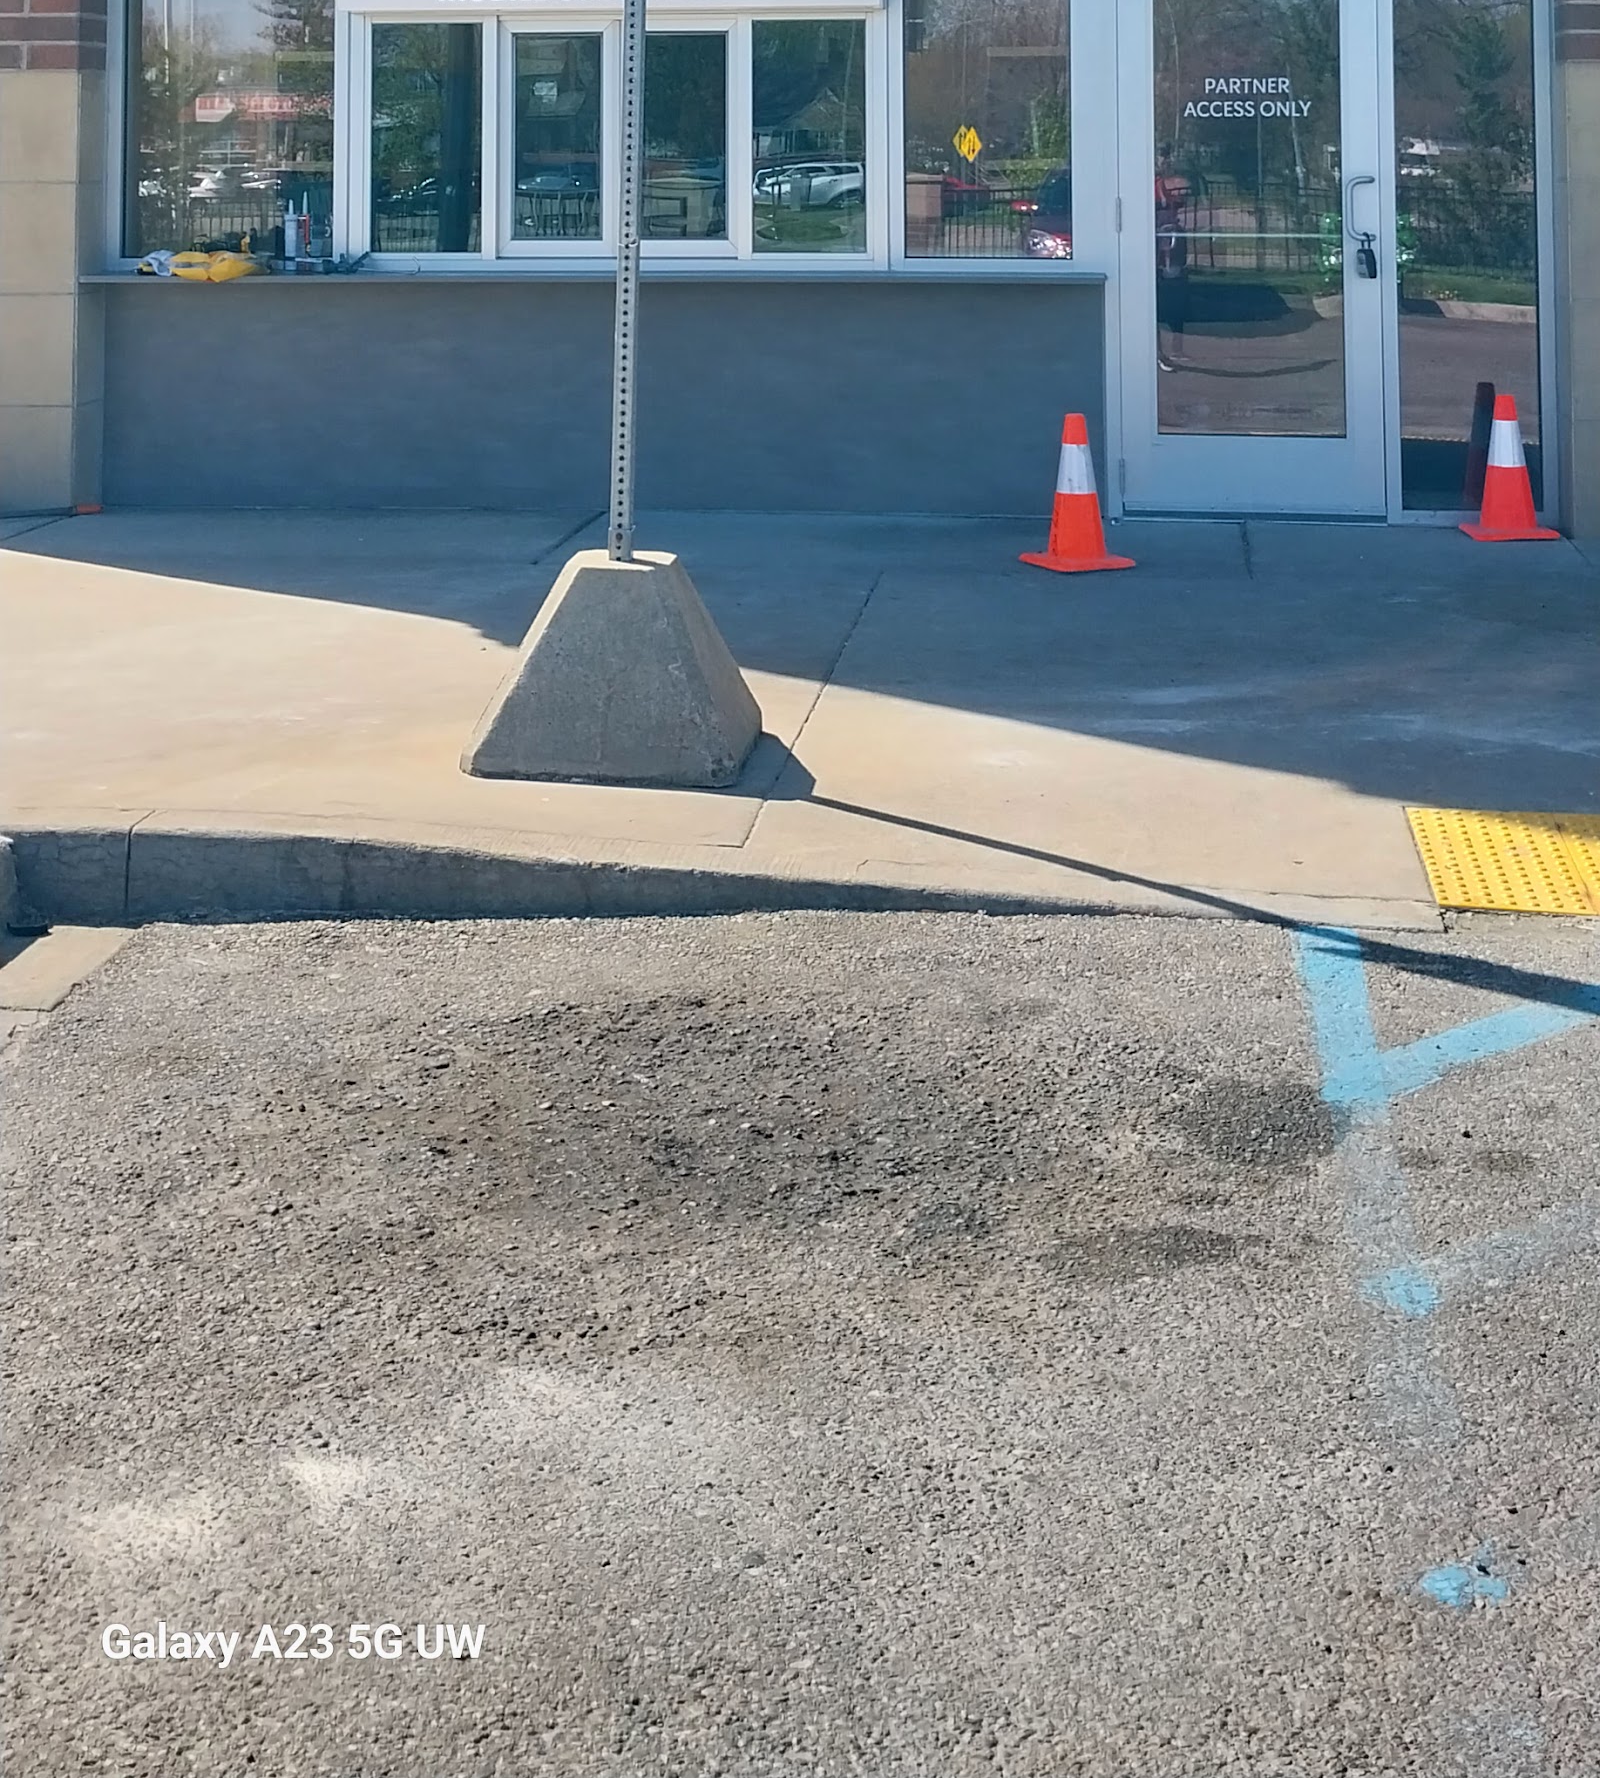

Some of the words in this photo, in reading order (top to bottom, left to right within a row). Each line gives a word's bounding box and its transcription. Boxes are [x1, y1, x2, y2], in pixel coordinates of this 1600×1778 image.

[1204, 78, 1290, 95] PARTNER
[1184, 101, 1255, 118] ACCESS
[1259, 100, 1312, 117] ONLY
